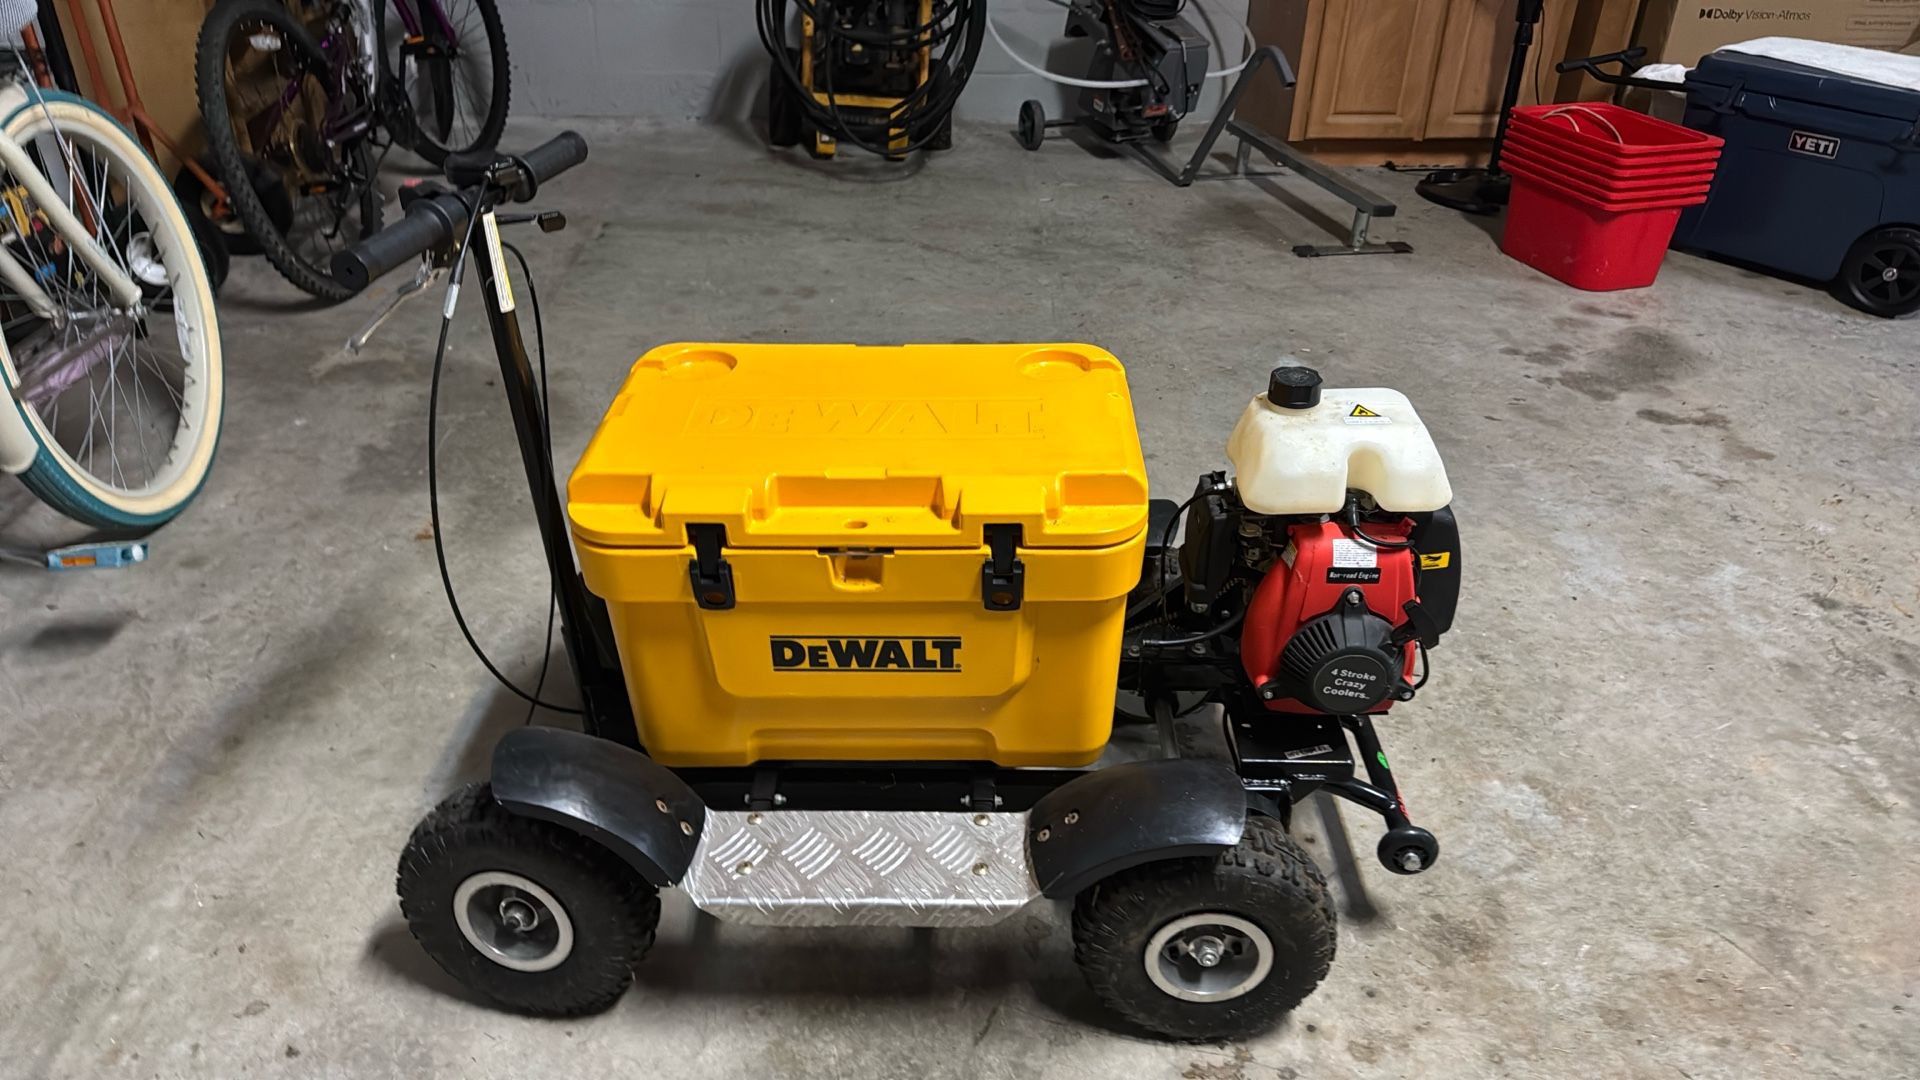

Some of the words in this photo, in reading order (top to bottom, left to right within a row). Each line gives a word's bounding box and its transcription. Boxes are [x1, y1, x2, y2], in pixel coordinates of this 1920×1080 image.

[1713, 8, 1744, 23] Dolby
[1794, 134, 1835, 155] YETI
[1358, 571, 1379, 580] Engine
[770, 639, 962, 669] DEWALT
[1330, 668, 1339, 676] 4
[1340, 669, 1377, 681] Stroke
[1334, 678, 1366, 690] Crazy
